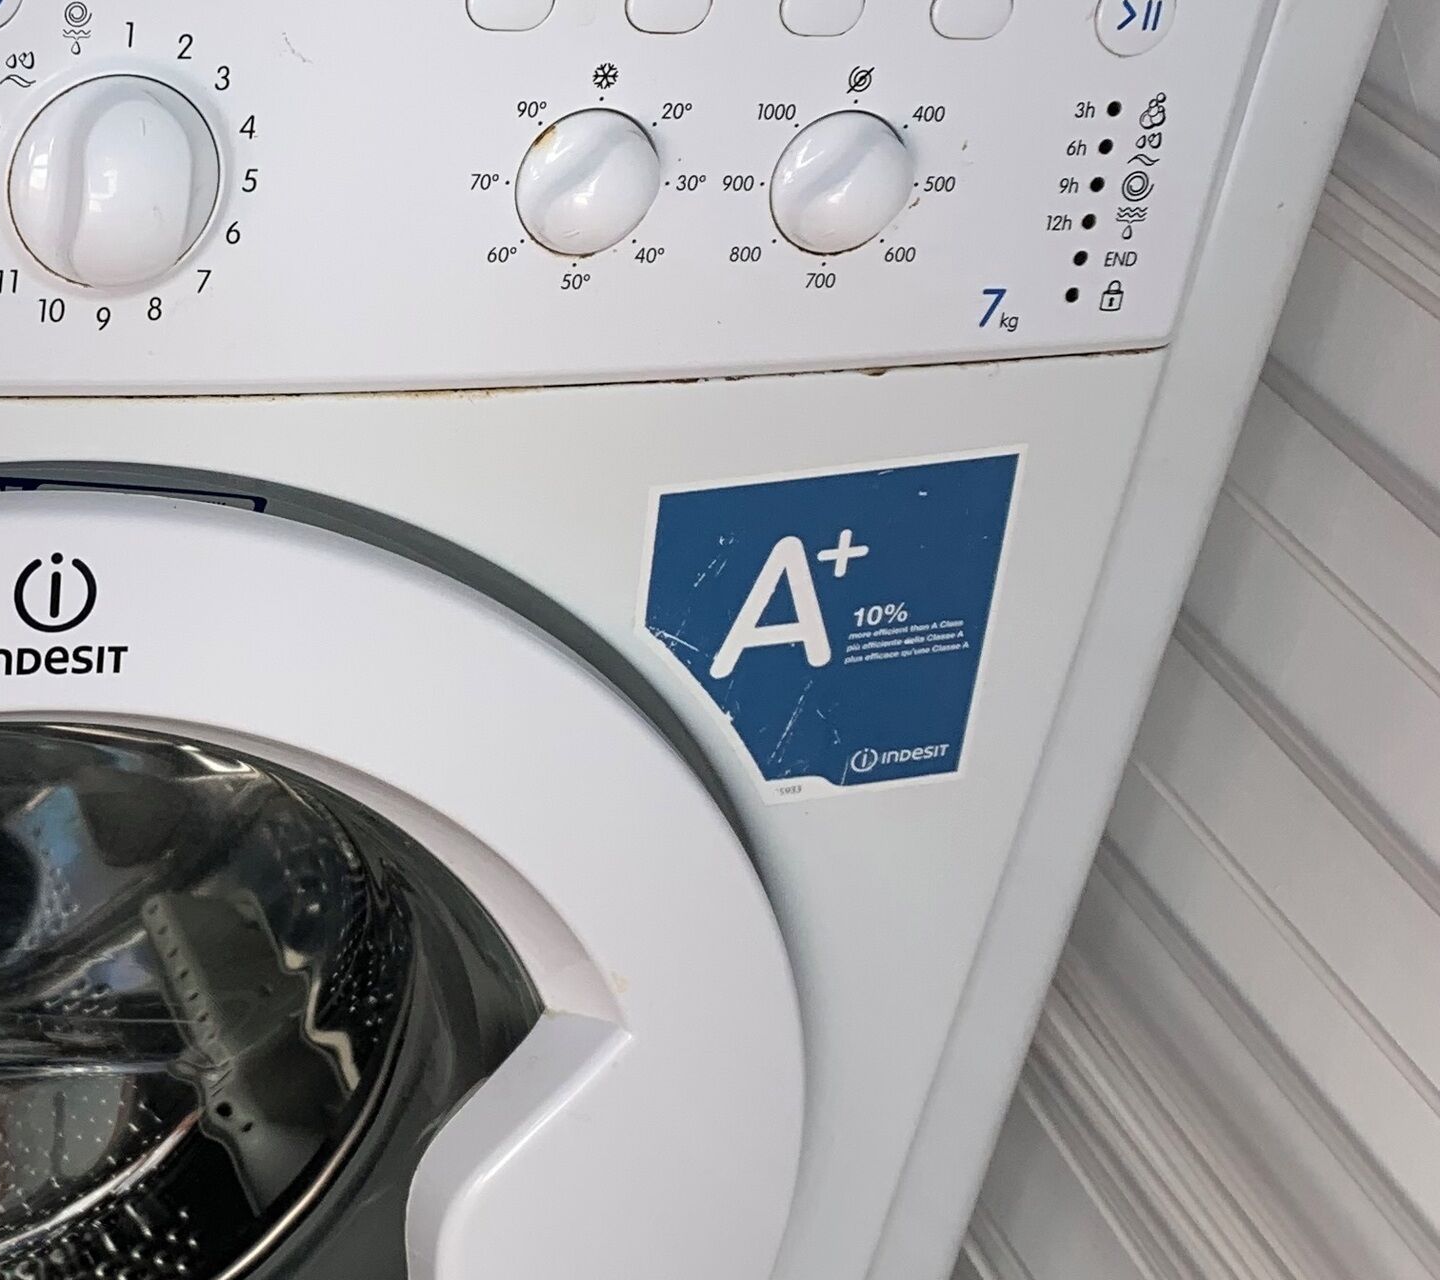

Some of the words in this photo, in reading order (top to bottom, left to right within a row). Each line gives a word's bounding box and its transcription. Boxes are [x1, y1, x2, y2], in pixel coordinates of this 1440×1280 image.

[125, 22, 134, 48] 1
[178, 34, 193, 59] 2
[215, 66, 230, 90] 3
[517, 101, 547, 118] 90°
[662, 103, 692, 120] 20°
[757, 103, 796, 121] 1000
[912, 106, 945, 122] 400
[1074, 102, 1095, 118] 3h
[240, 116, 256, 139] 4
[1066, 139, 1087, 156] 6h
[242, 169, 258, 192] 5
[471, 174, 499, 191] 70°
[676, 175, 706, 192] 30°
[722, 176, 754, 192] 900
[923, 176, 955, 193] 500
[1059, 178, 1079, 193] 9h
[1046, 215, 1072, 231] 12h
[226, 221, 241, 244] 6
[487, 247, 517, 263] 60°
[635, 247, 664, 264] 40°
[729, 247, 761, 262] 800
[884, 247, 916, 262] 600
[1104, 251, 1137, 267] END
[197, 270, 212, 293] 7
[560, 274, 590, 290] 50°
[805, 274, 835, 288] 700
[39, 298, 65, 322] 10
[147, 297, 161, 320] 8
[96, 307, 111, 330] 9
[709, 529, 869, 679] A+
[853, 602, 908, 627] 10%
[881, 744, 949, 766] INDESIT
